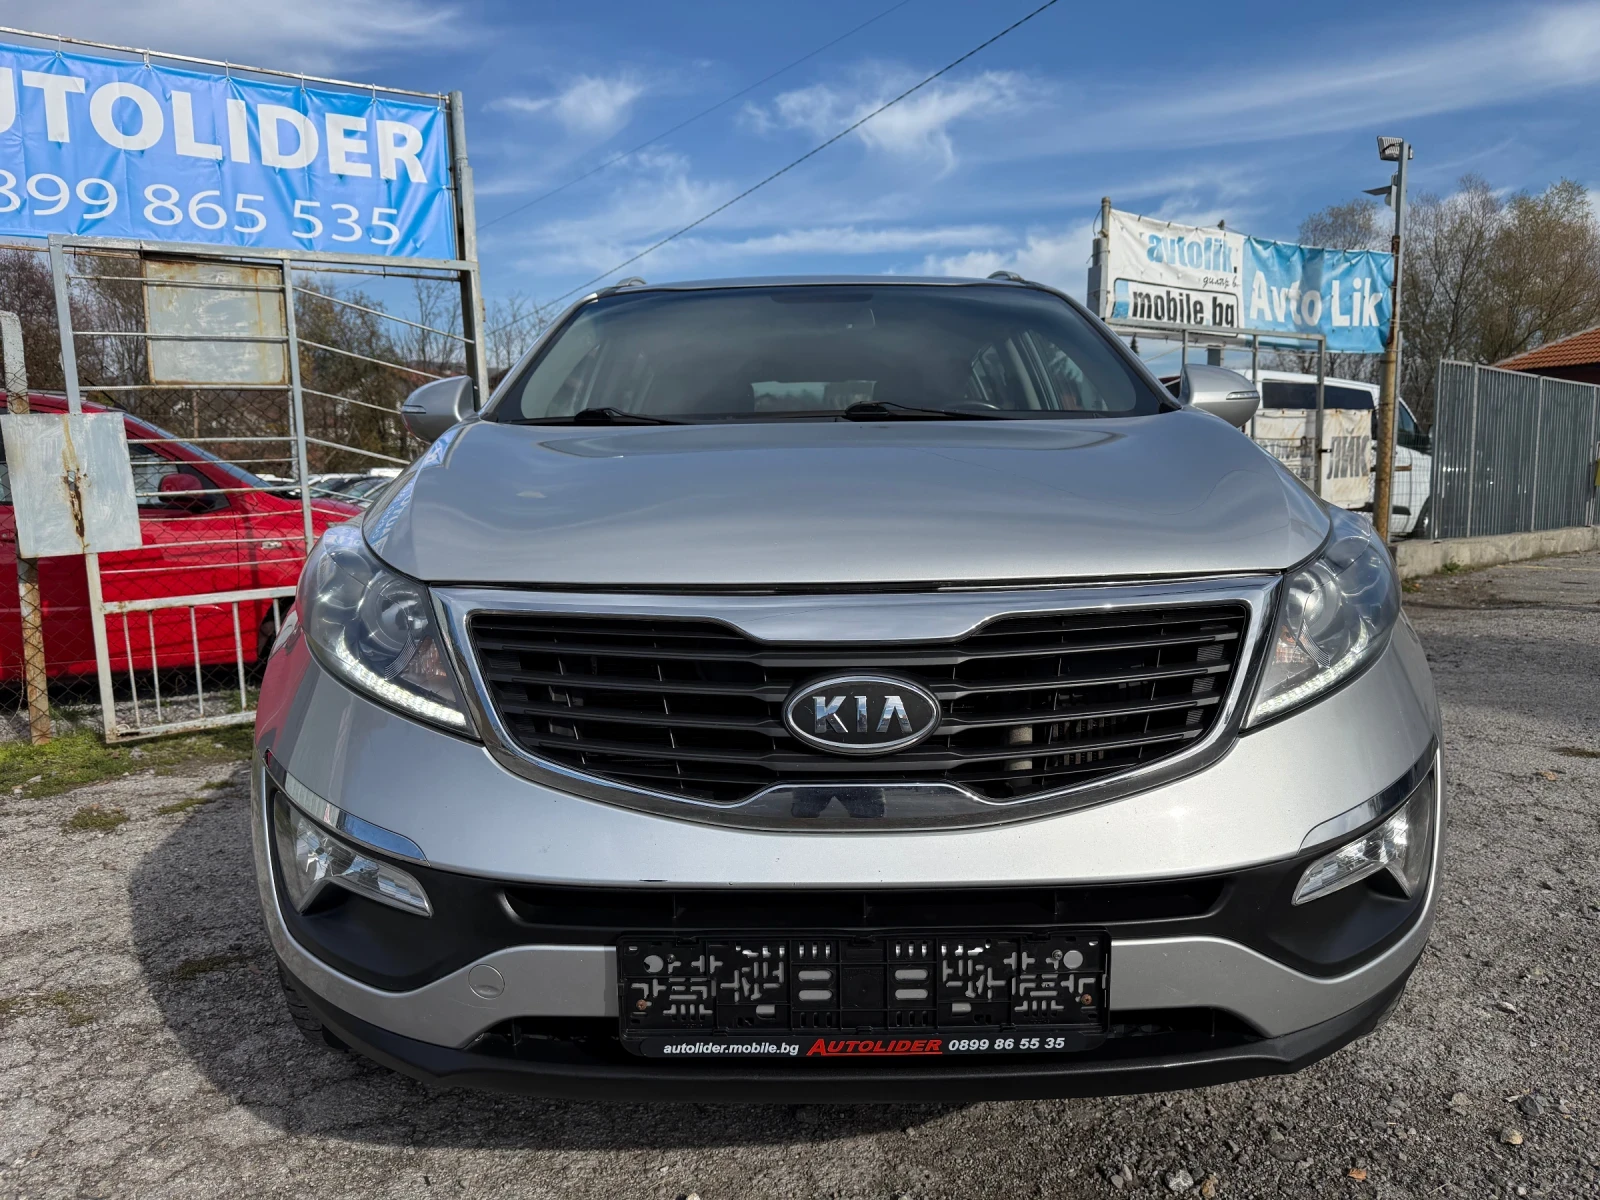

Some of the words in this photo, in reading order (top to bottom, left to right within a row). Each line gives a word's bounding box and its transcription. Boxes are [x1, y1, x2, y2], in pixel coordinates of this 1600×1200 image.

[143, 183, 267, 234] 865
[291, 199, 400, 246] 535
[1131, 289, 1235, 328] mobile.bg
[1249, 269, 1322, 327] Avto
[1331, 277, 1383, 327] Lik
[812, 695, 913, 733] KIA
[663, 1042, 799, 1056] autolider.mobile.bg
[806, 1038, 943, 1056] AUTOLIDER
[948, 1039, 989, 1051] 0899
[994, 1038, 1014, 1050] 86
[1019, 1038, 1040, 1049] 55
[1044, 1037, 1065, 1049] 35
